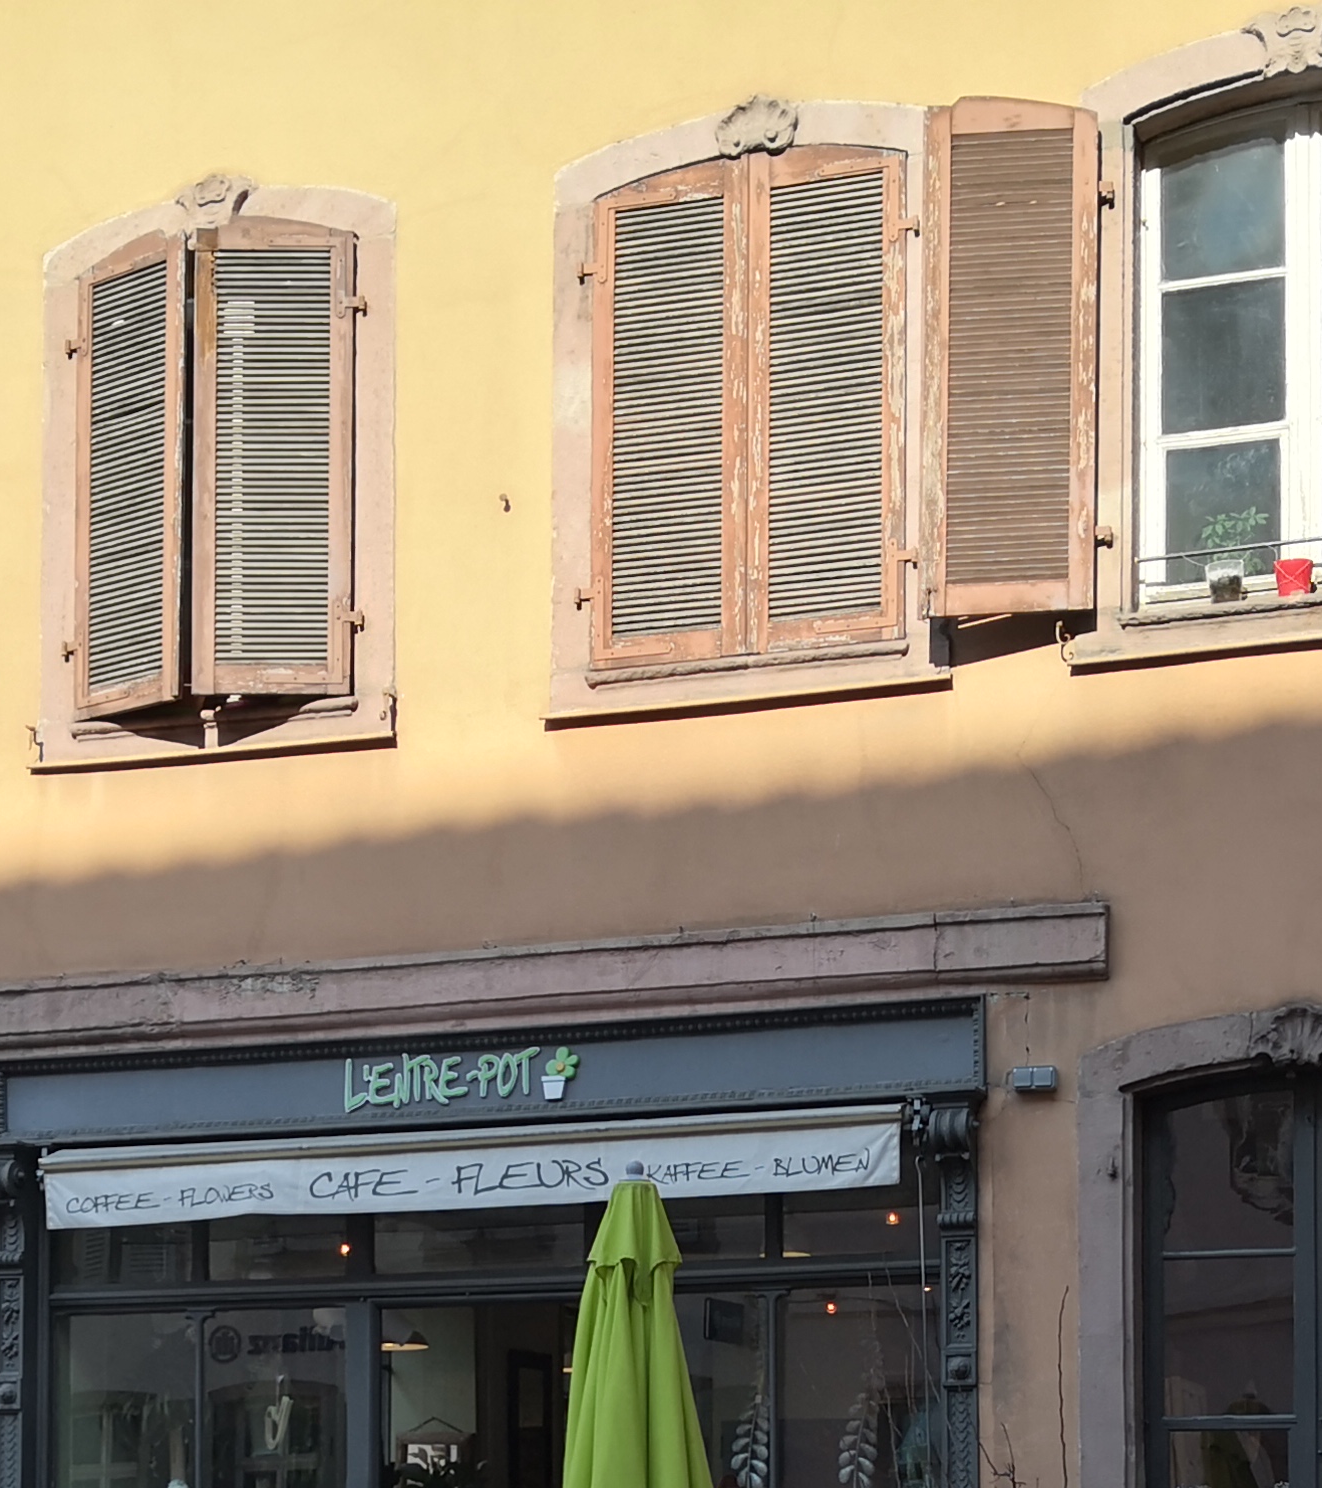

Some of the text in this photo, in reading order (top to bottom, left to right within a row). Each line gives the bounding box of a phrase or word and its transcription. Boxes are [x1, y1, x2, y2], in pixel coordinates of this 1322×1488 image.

[345, 1046, 540, 1113] L'ENTRE-POT
[66, 1192, 161, 1214] COFFEE
[177, 1182, 275, 1208] FLOWERS
[309, 1168, 419, 1202] CAFE
[451, 1157, 610, 1196] FLEURS
[646, 1160, 752, 1185] KAFFEE
[772, 1148, 870, 1178] BLUMEN
